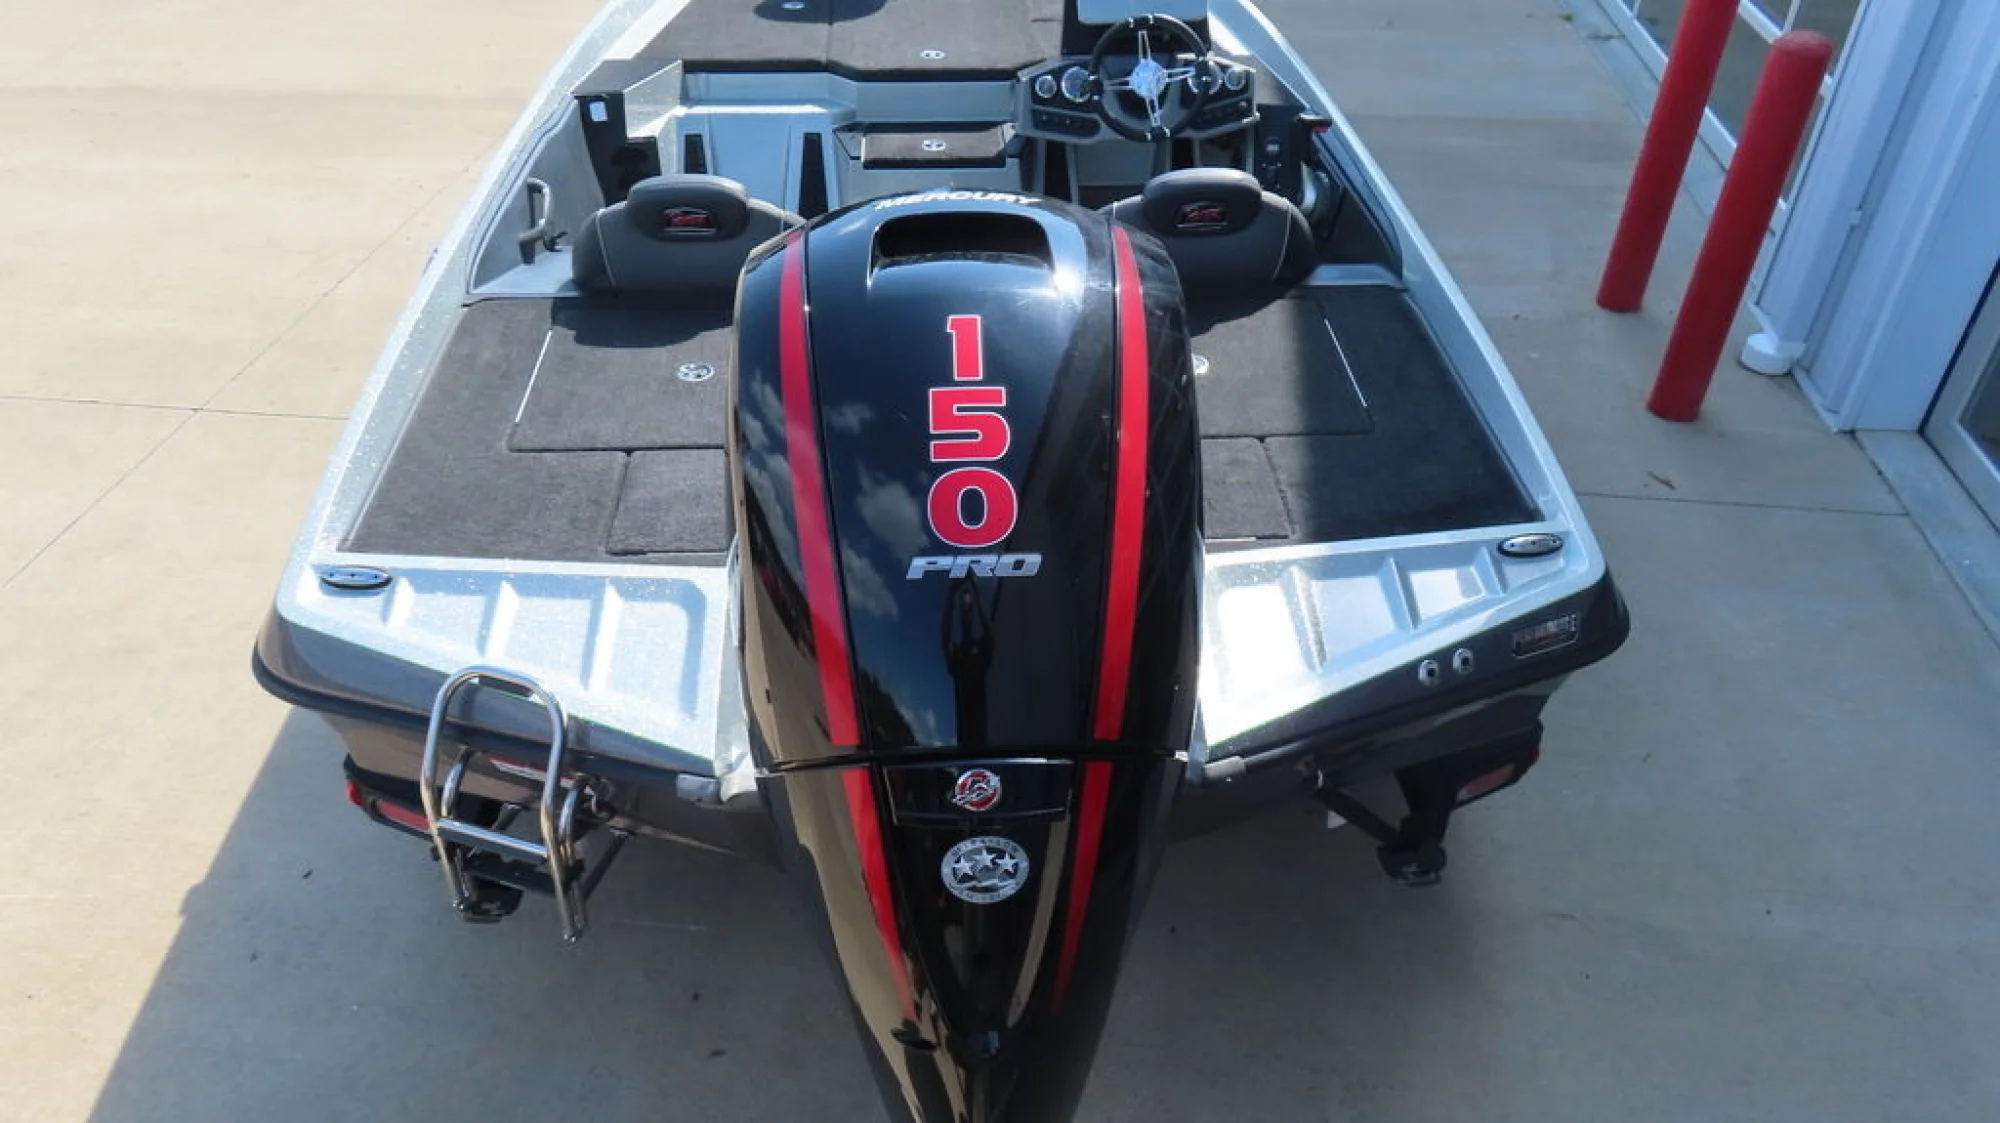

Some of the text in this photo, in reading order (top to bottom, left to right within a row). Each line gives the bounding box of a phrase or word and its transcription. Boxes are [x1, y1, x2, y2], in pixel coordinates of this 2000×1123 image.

[874, 190, 1043, 210] MERCURY
[928, 315, 1018, 547] 150
[906, 554, 1042, 580] PRO
